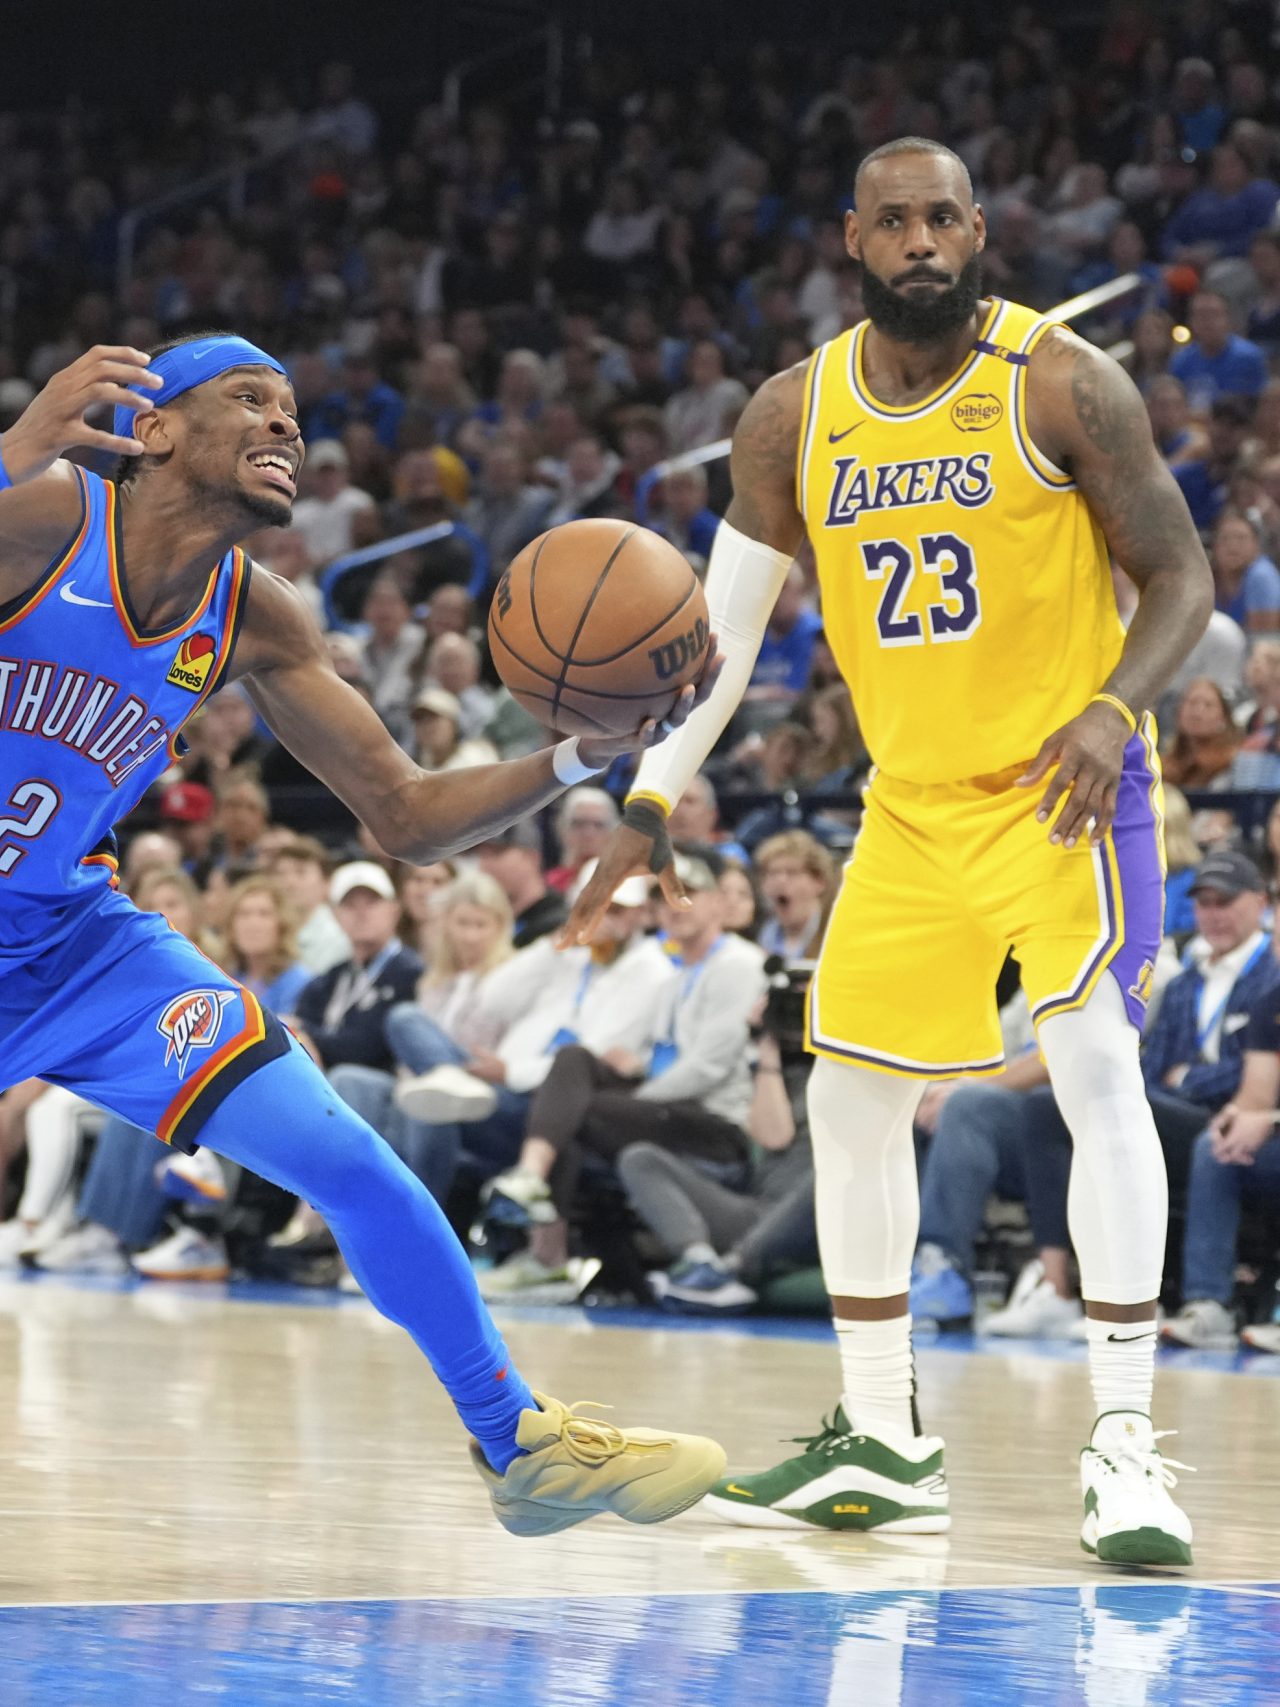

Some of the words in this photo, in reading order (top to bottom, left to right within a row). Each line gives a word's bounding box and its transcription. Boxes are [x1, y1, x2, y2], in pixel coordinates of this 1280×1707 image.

[956, 403, 1000, 420] bibigo
[823, 452, 996, 528] LAKERS
[858, 531, 983, 649] 23
[172, 997, 208, 1060] OKC
